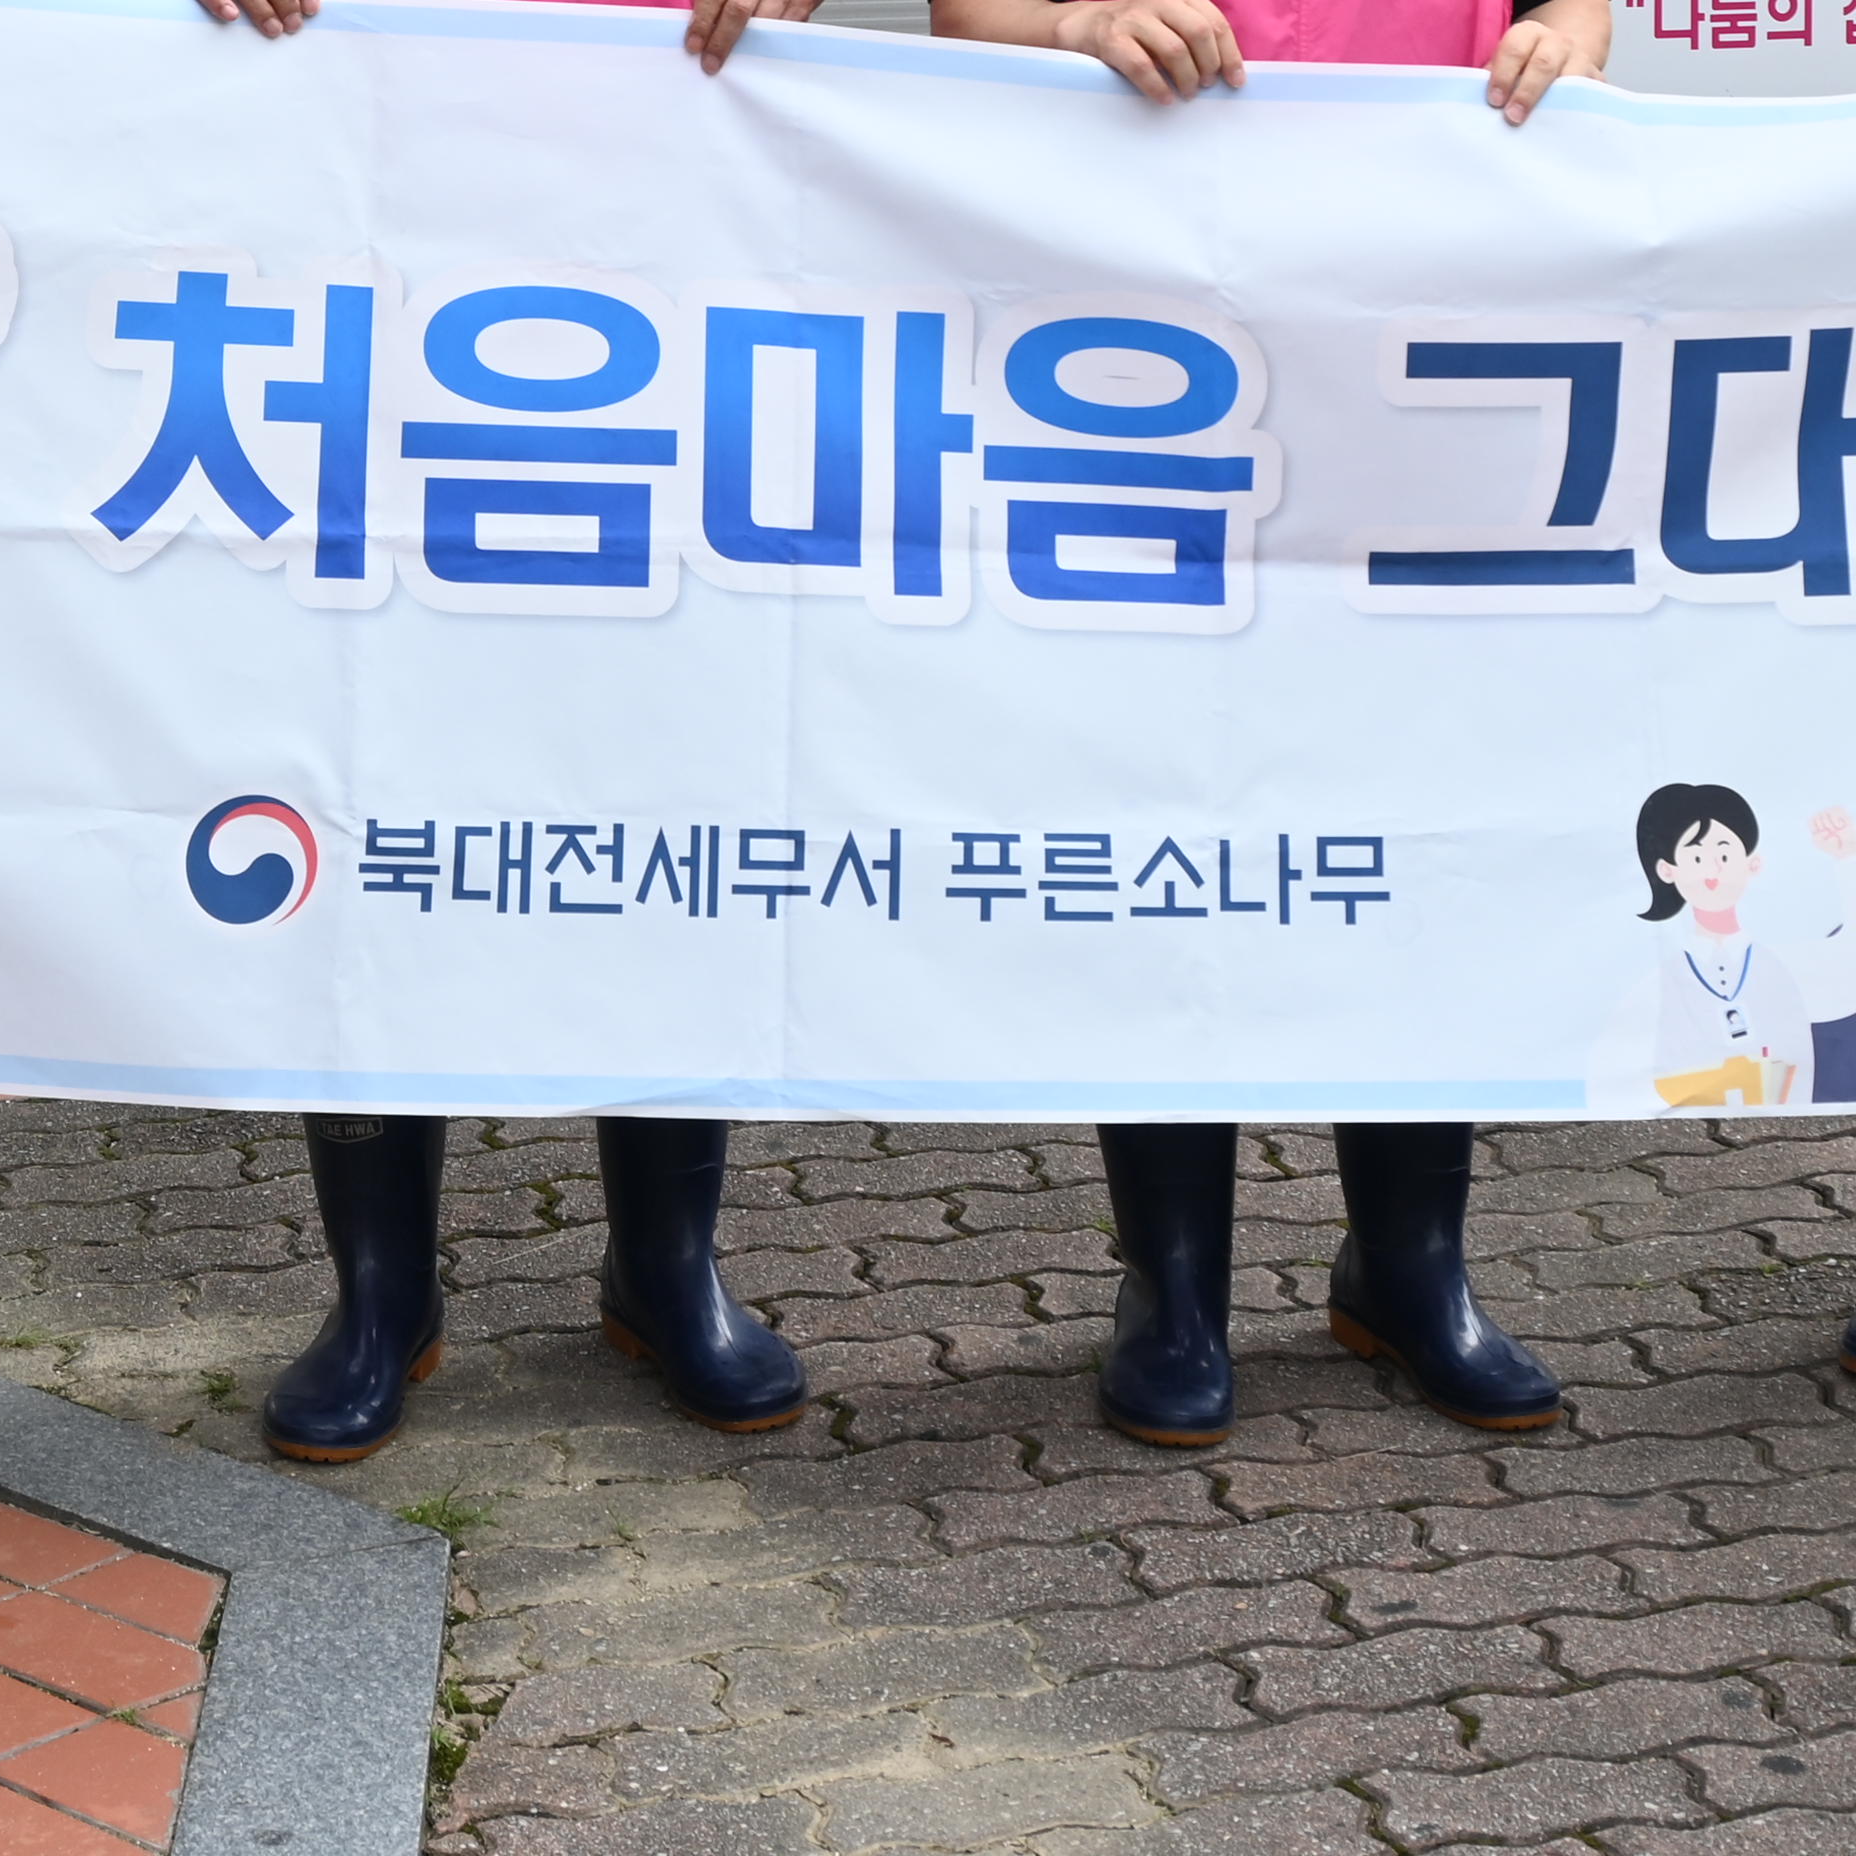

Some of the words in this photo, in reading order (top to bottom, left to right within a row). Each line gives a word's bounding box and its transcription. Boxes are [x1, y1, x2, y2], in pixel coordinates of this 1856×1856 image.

[90, 270, 1254, 605] 처음마음
[357, 818, 903, 922] 북대전세무서
[945, 829, 1392, 928] 푸른소나무
